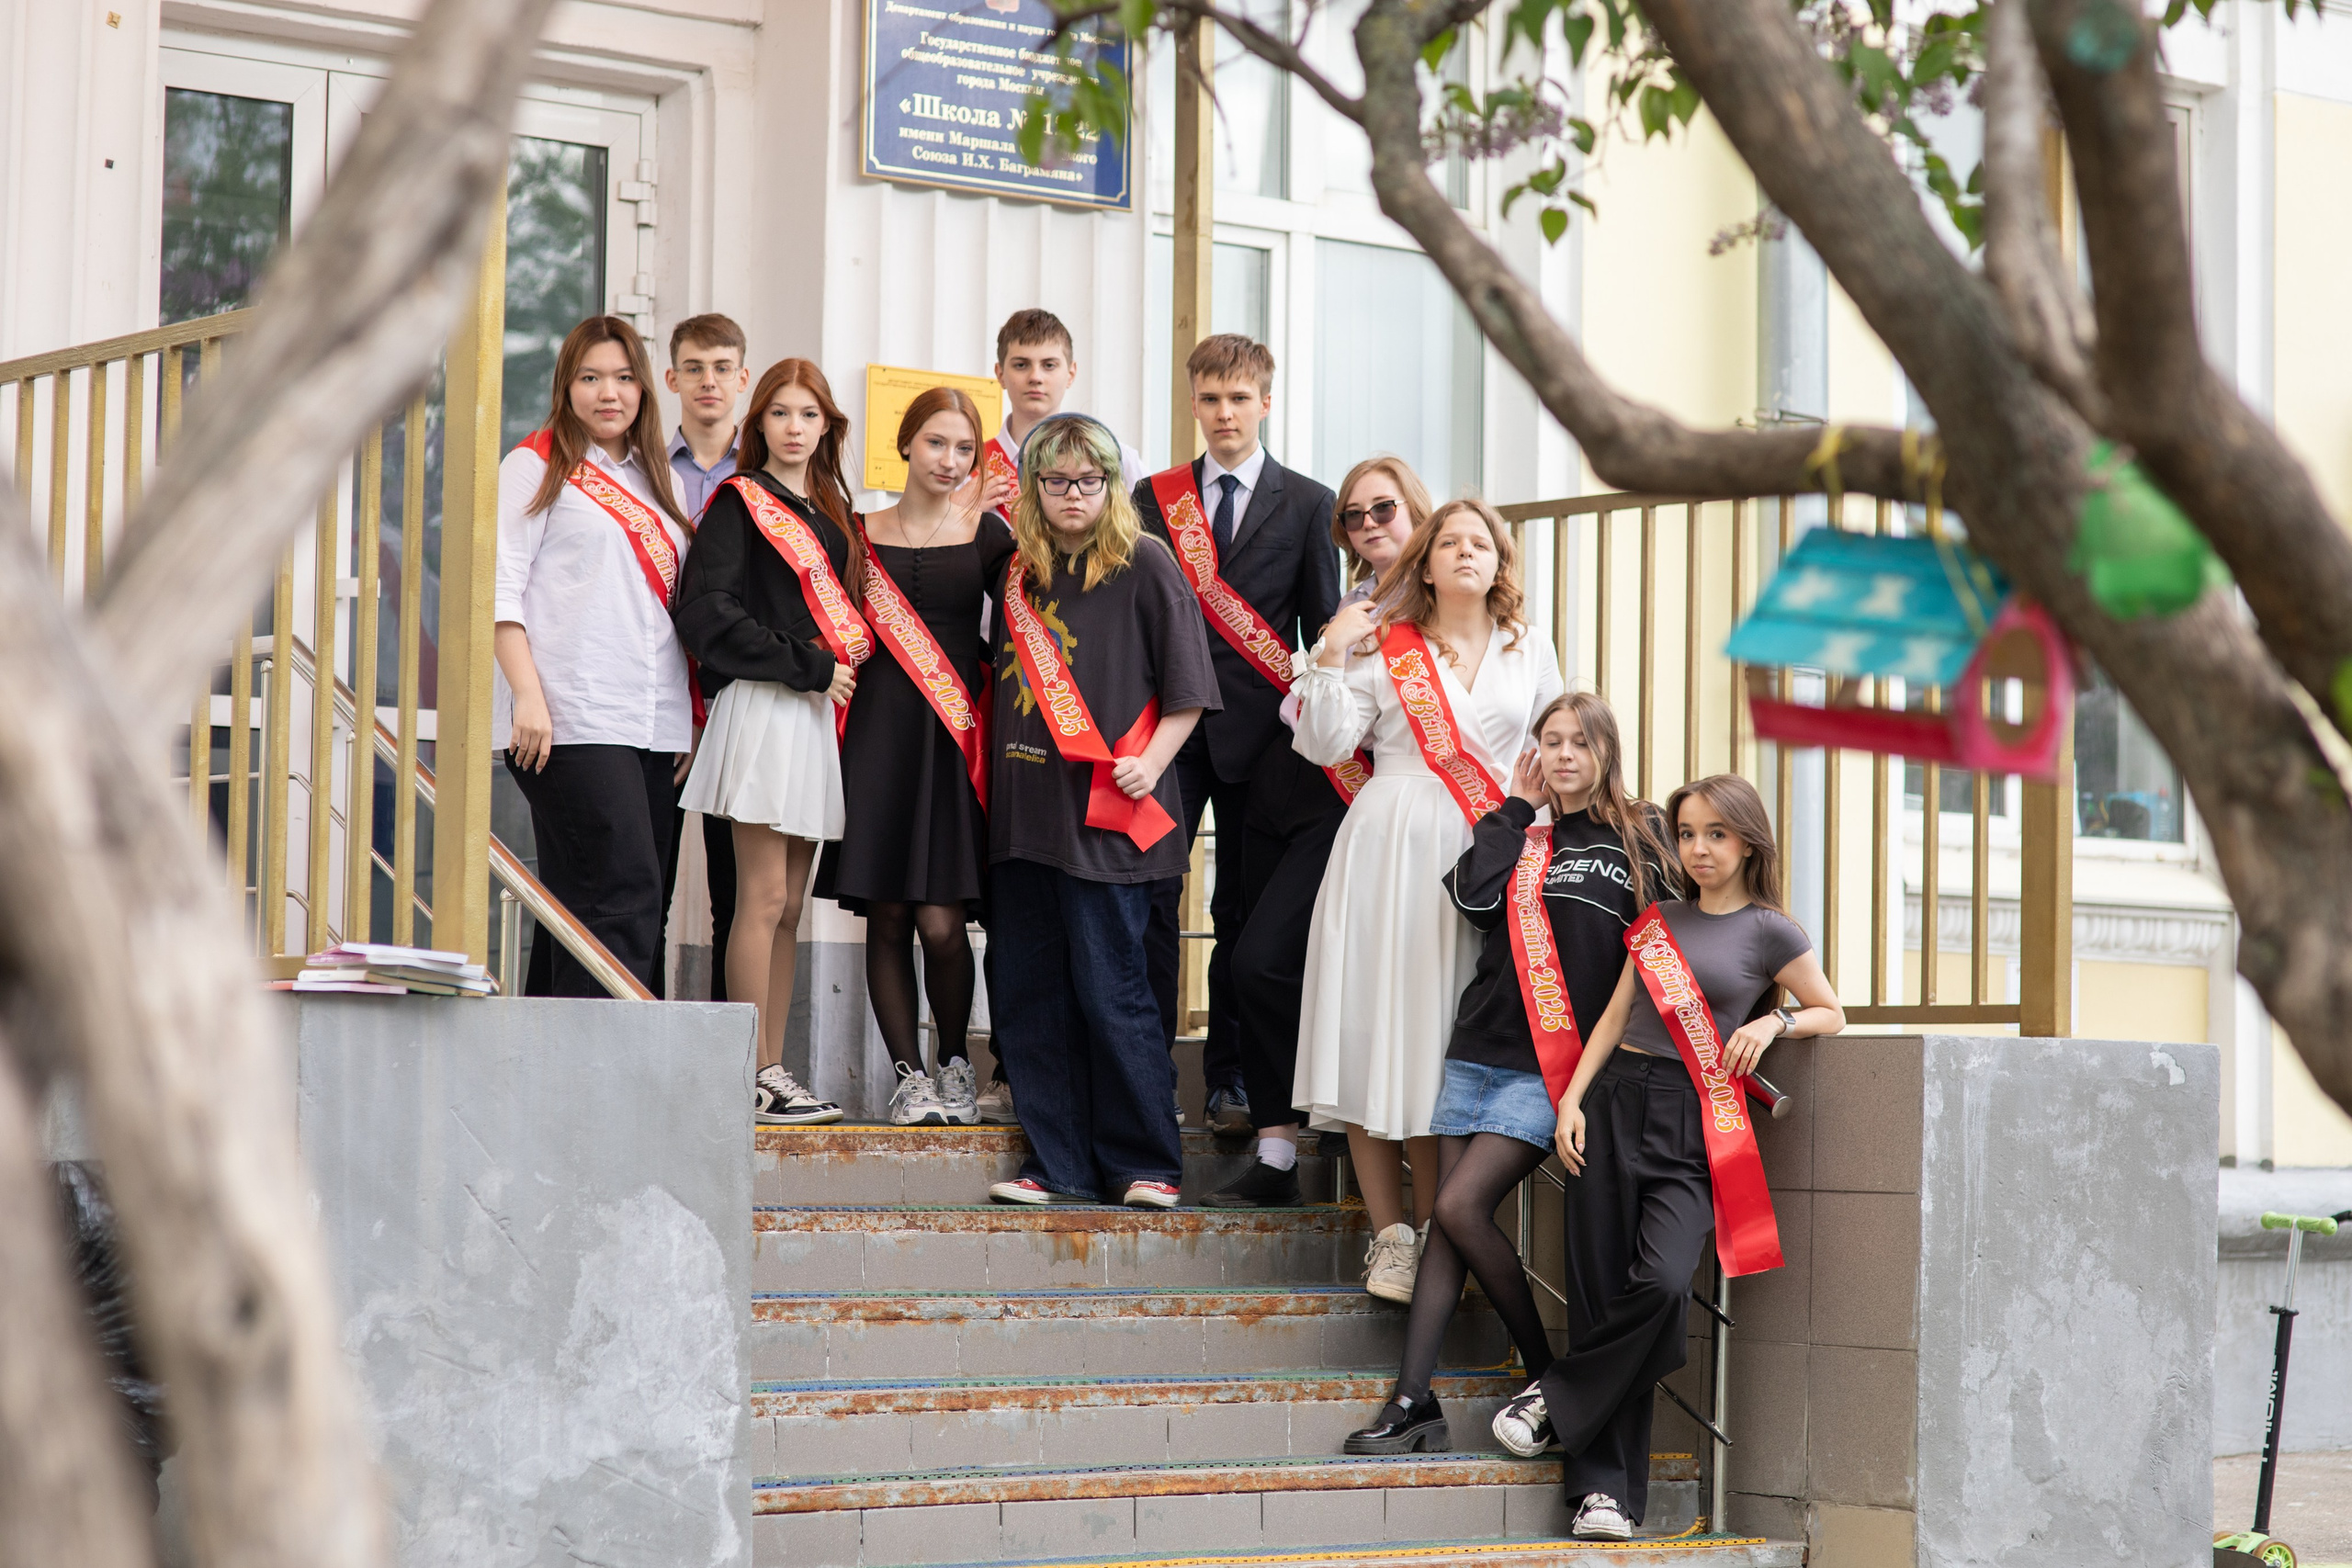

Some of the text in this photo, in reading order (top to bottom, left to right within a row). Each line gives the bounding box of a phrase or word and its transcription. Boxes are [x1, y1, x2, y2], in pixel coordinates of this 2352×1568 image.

[901, 47, 1026, 77] общеобразовательное
[921, 31, 1016, 60] Государственное
[956, 73, 996, 90] города
[899, 93, 1001, 129] «Школа
[899, 125, 1016, 154] имени Маршала
[911, 145, 957, 165] Союза
[834, 624, 870, 669] 202
[923, 672, 977, 731] 2025
[1044, 681, 1090, 737] 2025
[1528, 967, 1572, 1033] 2025
[1701, 1067, 1746, 1133] 2025
